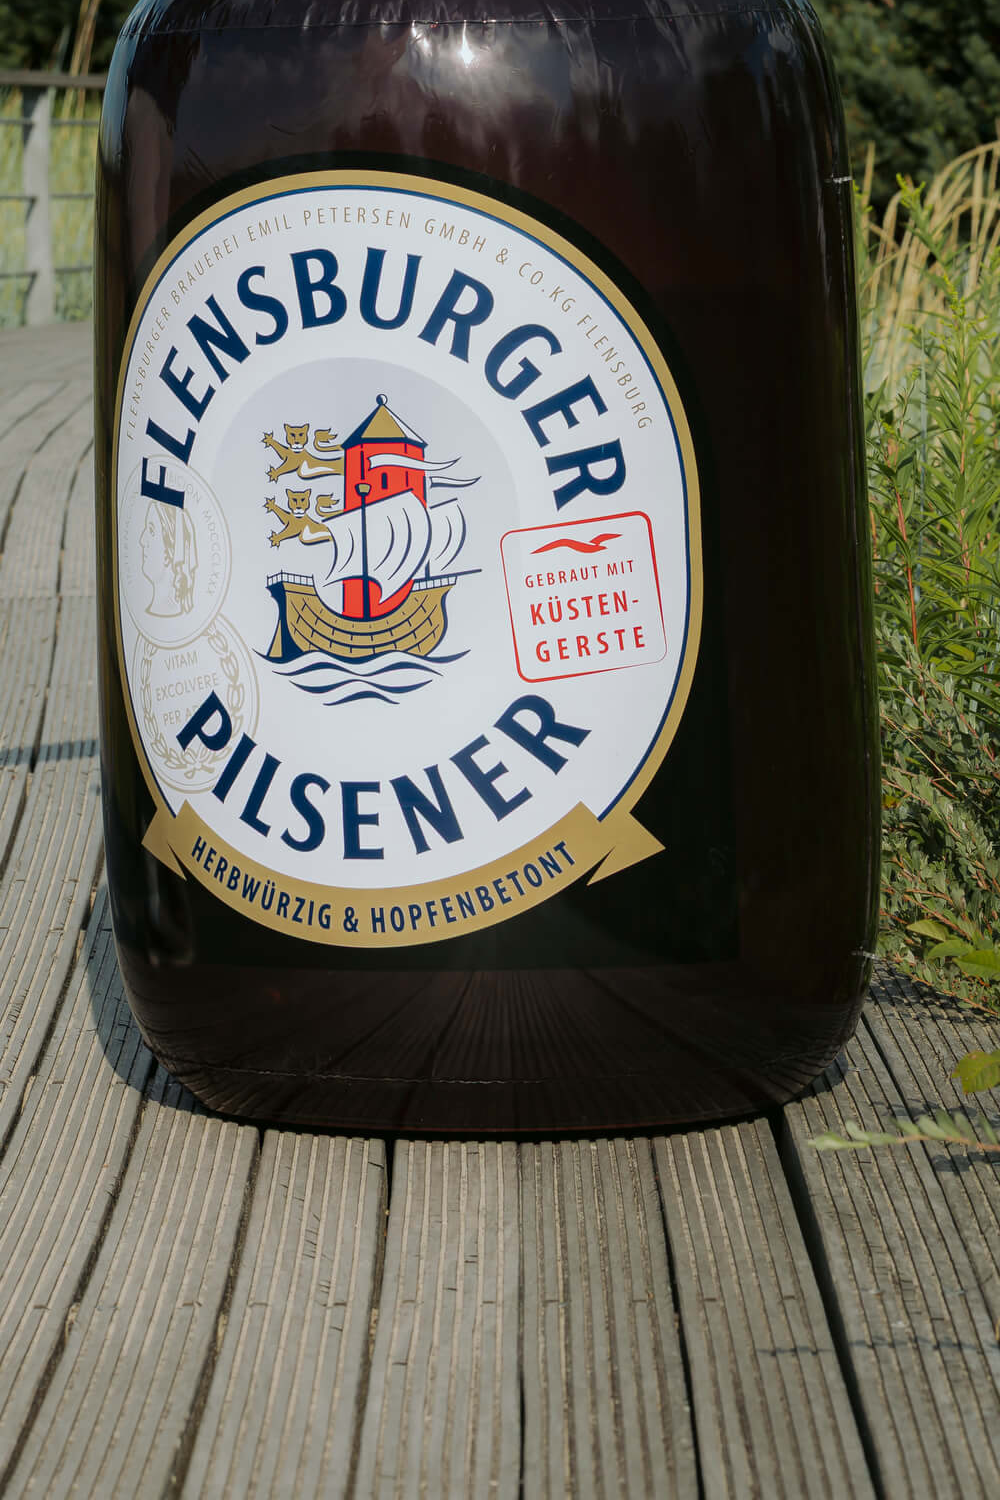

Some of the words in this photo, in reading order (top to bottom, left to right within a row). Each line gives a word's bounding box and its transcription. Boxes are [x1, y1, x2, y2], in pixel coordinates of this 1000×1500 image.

[126, 306, 172, 441] FLENSBURGER
[170, 234, 240, 306] BRAUEREI
[247, 213, 292, 242] EMIL
[303, 206, 411, 229] PETERSEN
[424, 218, 487, 253] GMBH
[495, 248, 509, 265] &
[576, 314, 653, 429] FLENSBURG
[139, 247, 627, 510] FLENSBURGER
[525, 565, 599, 589] GEBRAUT
[606, 559, 634, 577] MIT
[529, 589, 640, 627] KÜSTEN-
[164, 651, 199, 672] VITAM
[535, 625, 646, 663] GERSTE
[155, 672, 220, 702] EXCOLVERE
[162, 710, 183, 727] PER
[175, 690, 592, 862] PILSENER
[190, 835, 332, 931] HERBWÜRZIG
[342, 906, 360, 933] &
[370, 840, 577, 934] HOPFENBETONT
